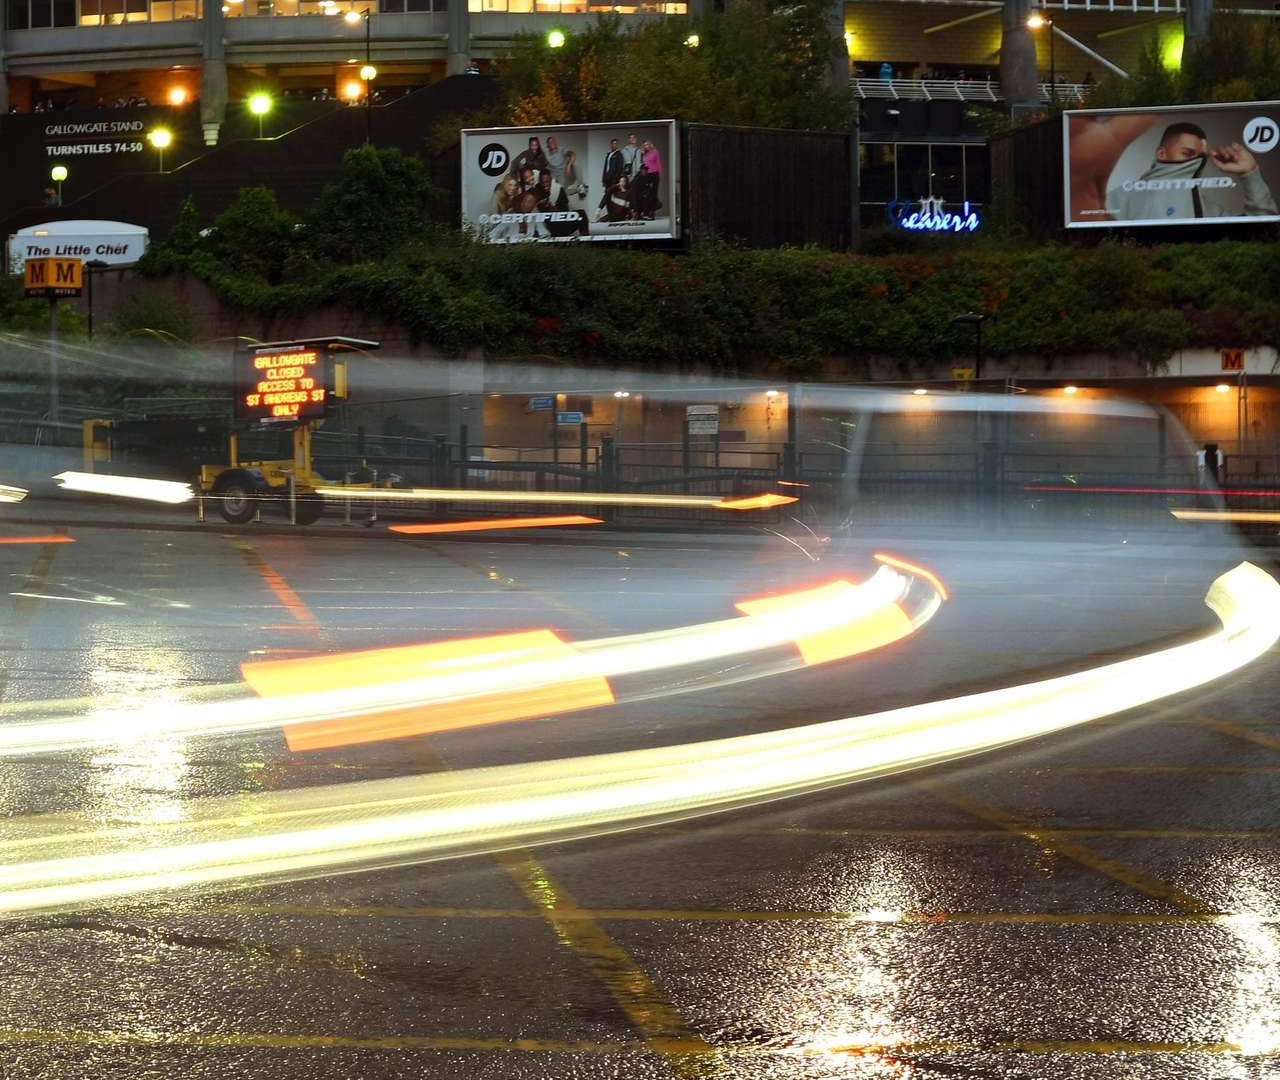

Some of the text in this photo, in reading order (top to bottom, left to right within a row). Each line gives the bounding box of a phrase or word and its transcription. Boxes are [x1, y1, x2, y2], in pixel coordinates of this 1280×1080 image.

[45, 121, 143, 135] GALLOWGATE STAND
[1248, 126, 1274, 143] JD
[46, 142, 143, 156] TURNSTILES 74-50
[482, 151, 506, 169] JD
[26, 243, 129, 256] The Little Chef
[30, 262, 45, 284] M
[55, 262, 75, 283] M
[254, 353, 316, 368] GALLOWGATE
[1225, 353, 1243, 368] M
[266, 367, 304, 379] CLOSED
[258, 378, 313, 392] ACCESS TO
[246, 389, 325, 406] ST ANDREWS ST
[273, 405, 299, 415] ONLY
